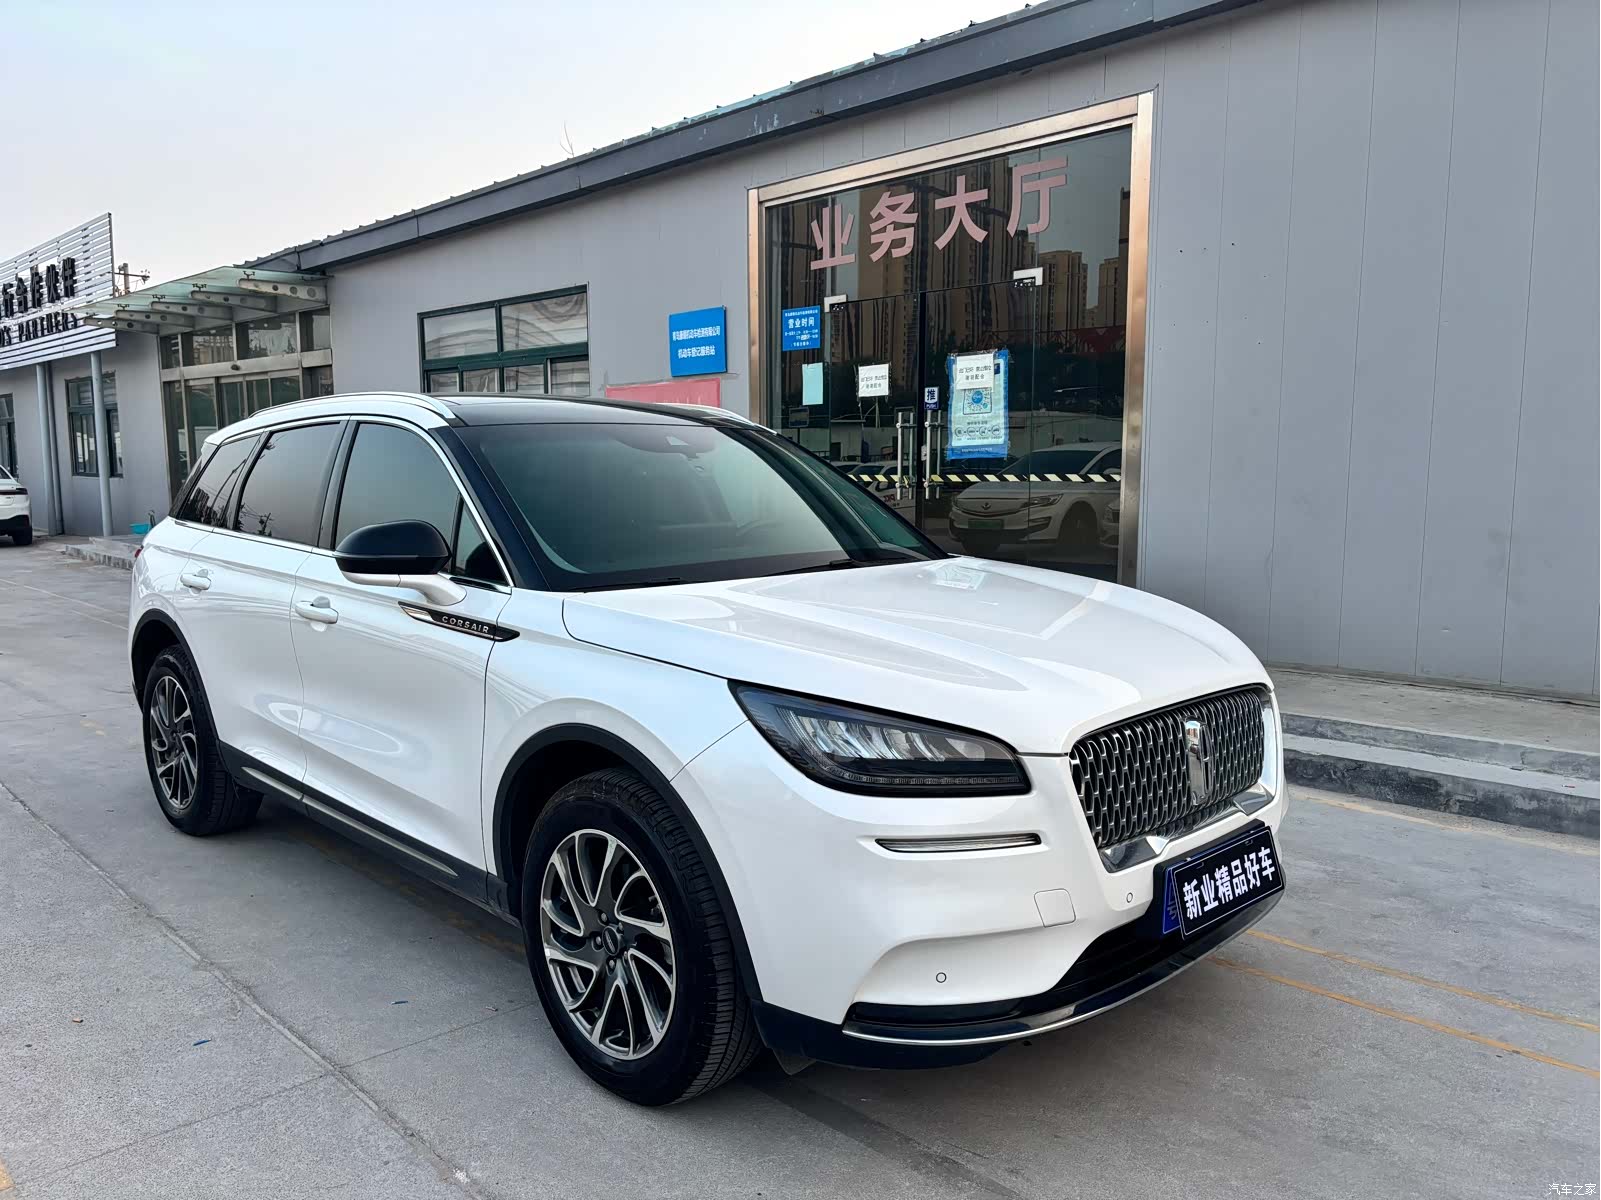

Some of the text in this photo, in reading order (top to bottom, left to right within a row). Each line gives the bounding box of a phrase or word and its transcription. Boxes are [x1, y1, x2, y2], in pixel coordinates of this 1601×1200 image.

[810, 154, 1068, 270] 业务大厅
[788, 316, 815, 329] 营业时间
[926, 388, 936, 401] 推
[441, 615, 490, 634] CORSAIR
[1182, 846, 1276, 920] 新业精品好车
